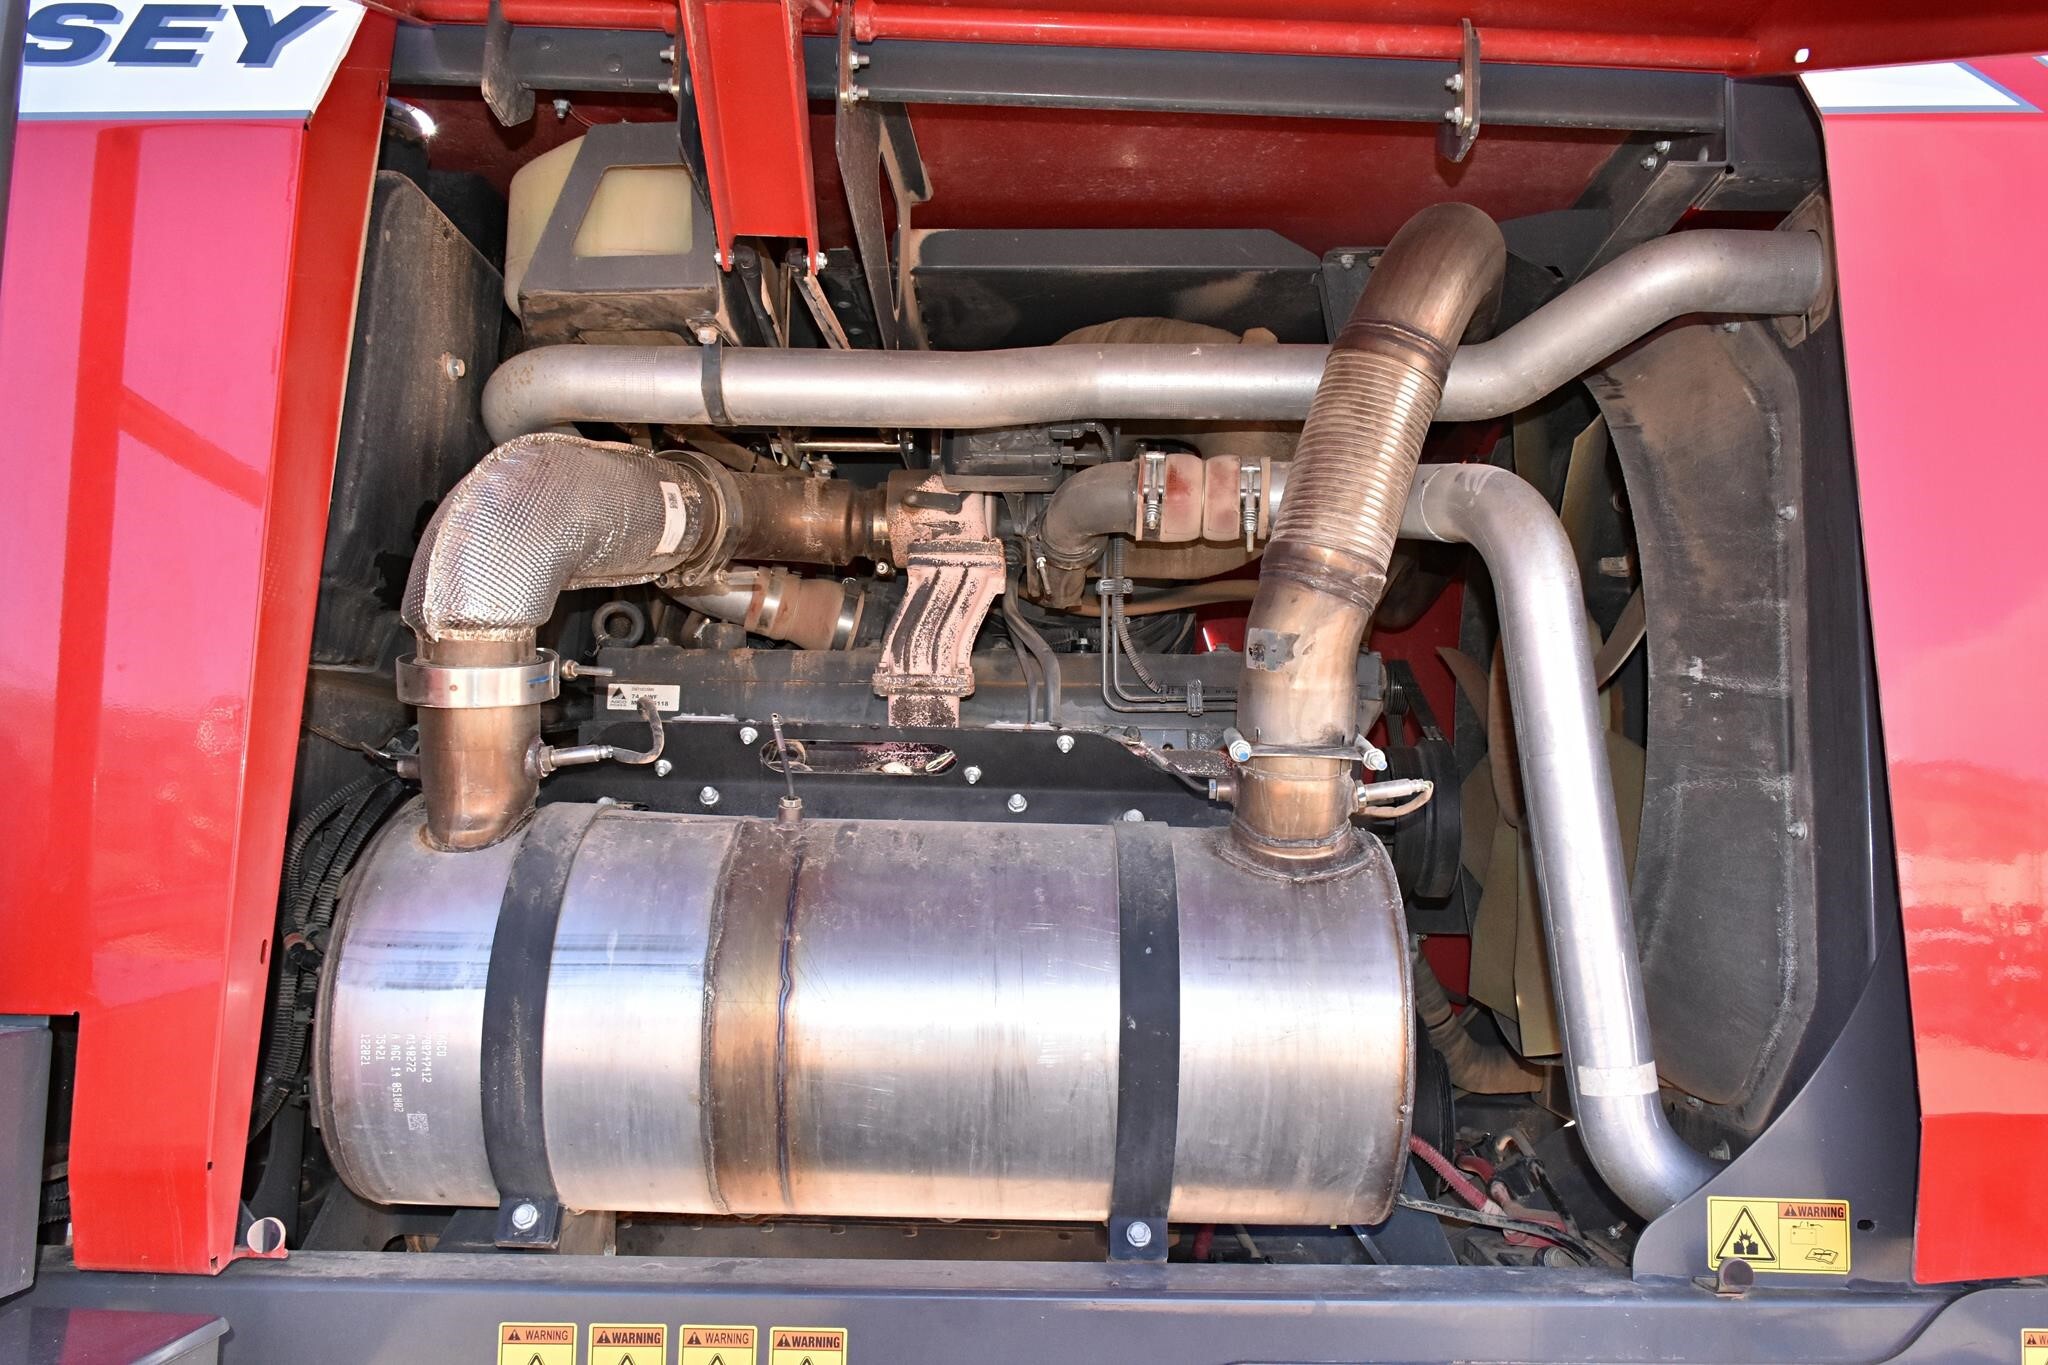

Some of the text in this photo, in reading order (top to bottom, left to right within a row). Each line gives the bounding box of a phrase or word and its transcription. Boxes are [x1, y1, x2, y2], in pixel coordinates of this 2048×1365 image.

[1797, 1205, 1844, 1218] WARNING
[525, 1329, 569, 1341] WARNING
[612, 1331, 661, 1344] WARNING
[705, 1332, 750, 1345] WARNING
[791, 1335, 841, 1349] WARNING
